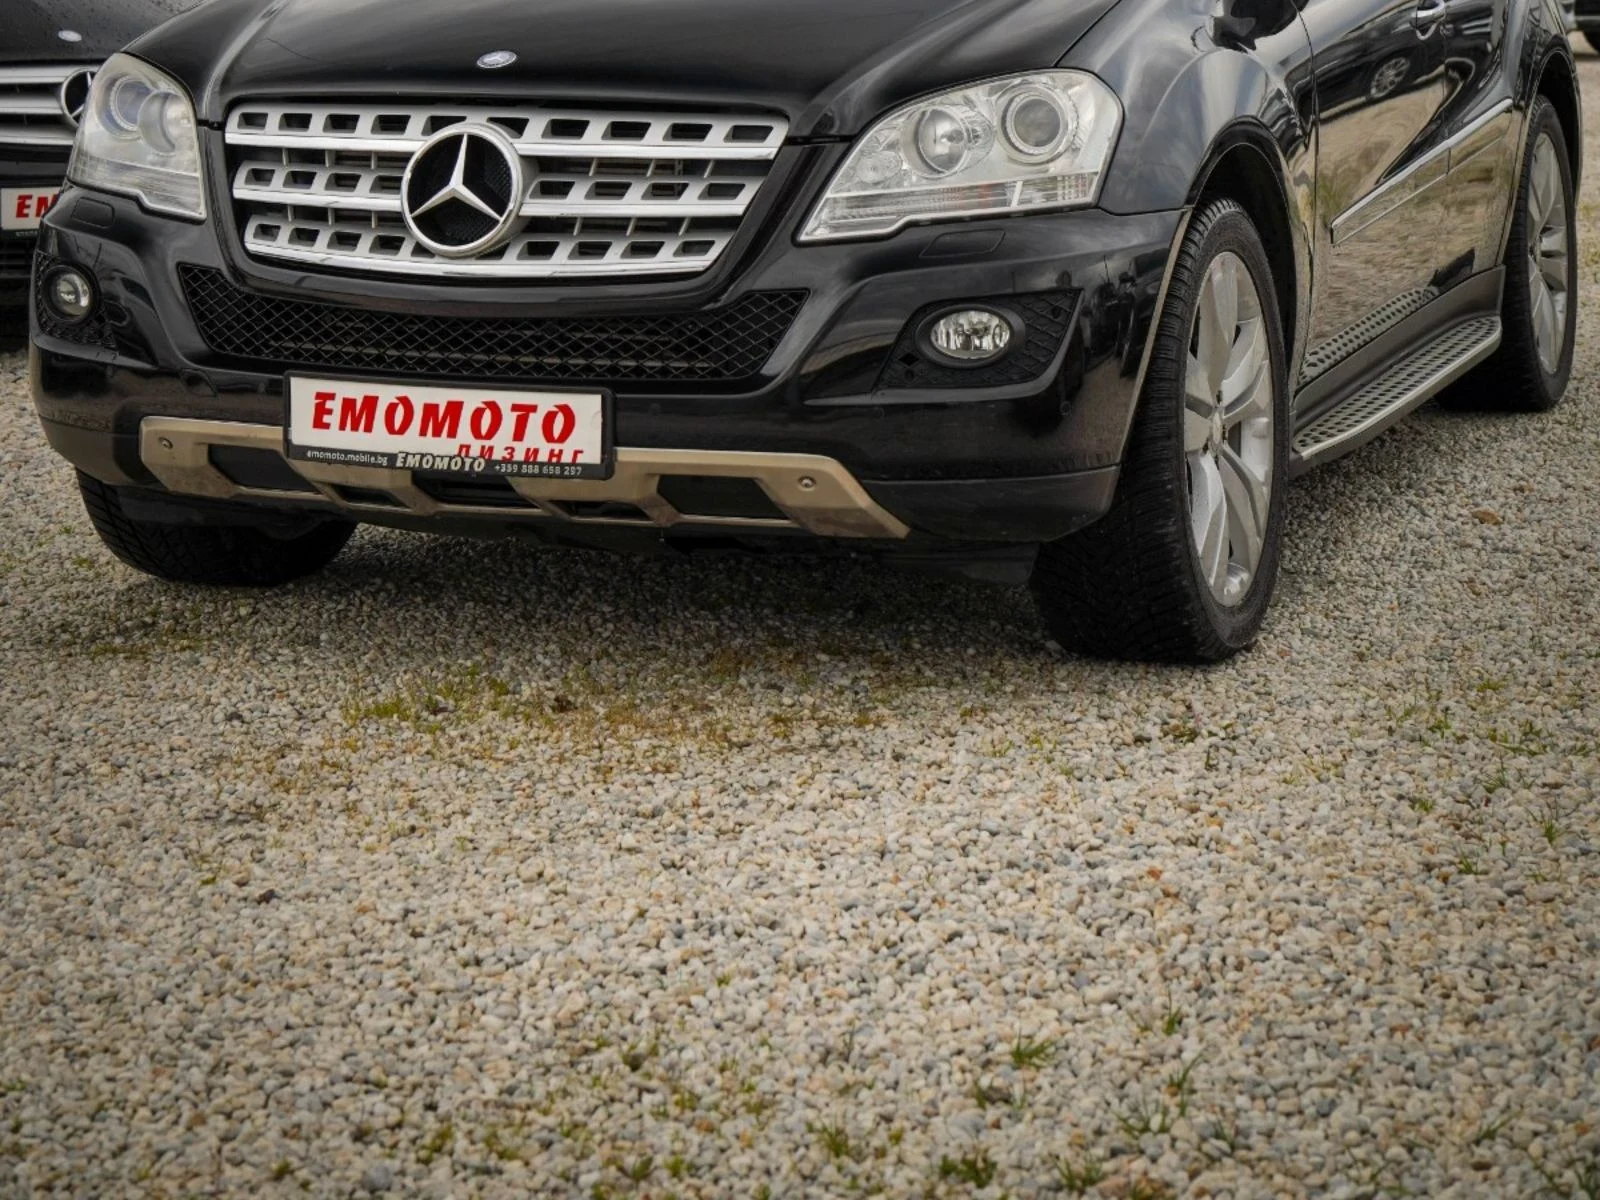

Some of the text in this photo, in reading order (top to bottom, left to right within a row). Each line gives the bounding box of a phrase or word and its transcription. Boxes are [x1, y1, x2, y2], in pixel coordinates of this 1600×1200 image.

[312, 391, 576, 444] EMOMOTO
[306, 450, 388, 466] emomoto.mobile.bg
[395, 452, 485, 472] EMOMOTO
